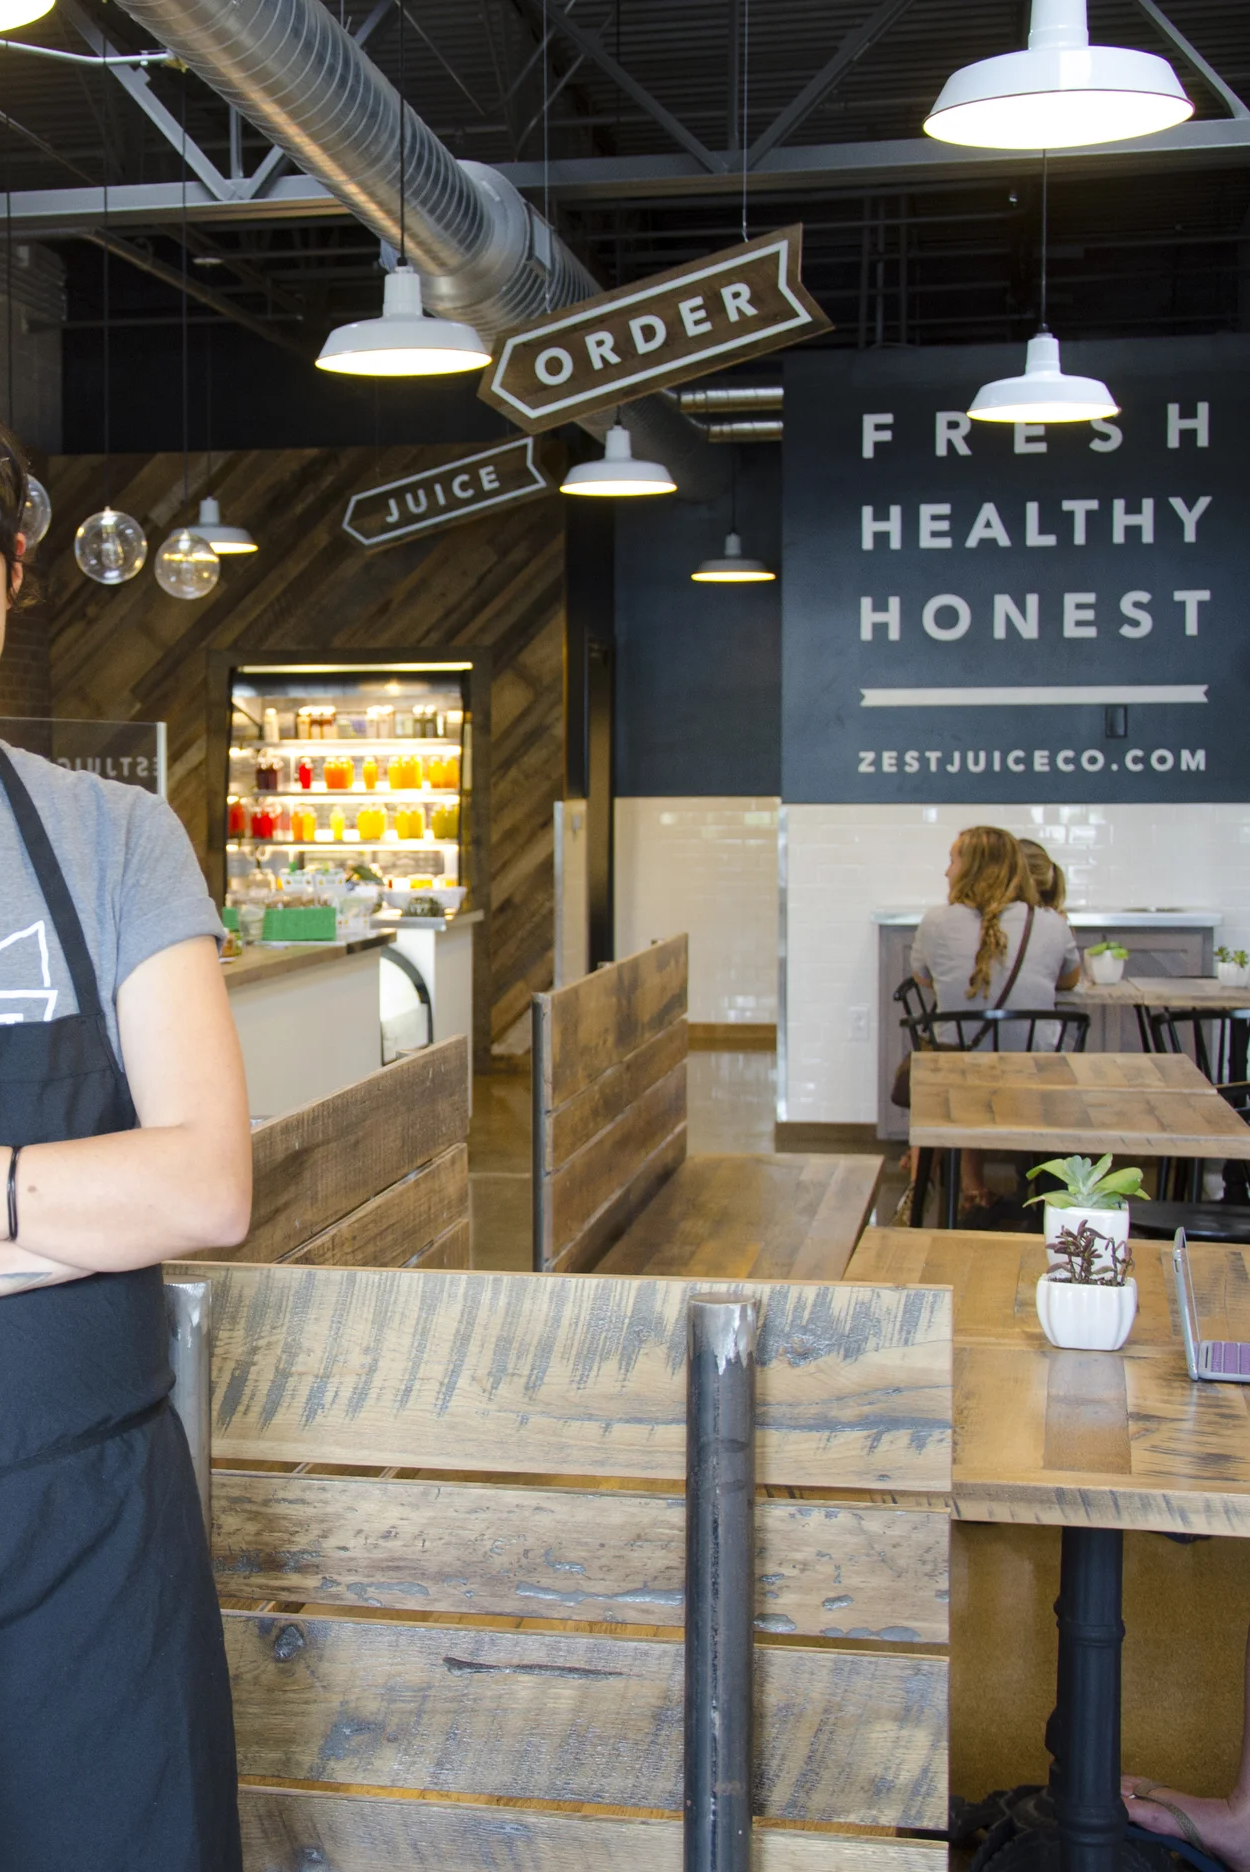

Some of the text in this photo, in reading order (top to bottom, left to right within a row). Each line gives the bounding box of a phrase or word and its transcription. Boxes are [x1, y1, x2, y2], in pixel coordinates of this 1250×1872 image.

[534, 282, 759, 387] ORDER
[861, 401, 1210, 459] FRESH
[384, 465, 501, 524] JUICE
[861, 496, 1213, 551] HEALTHY
[859, 589, 1212, 642] HONEST
[857, 748, 1207, 774] ZESTJUICECO.COM
